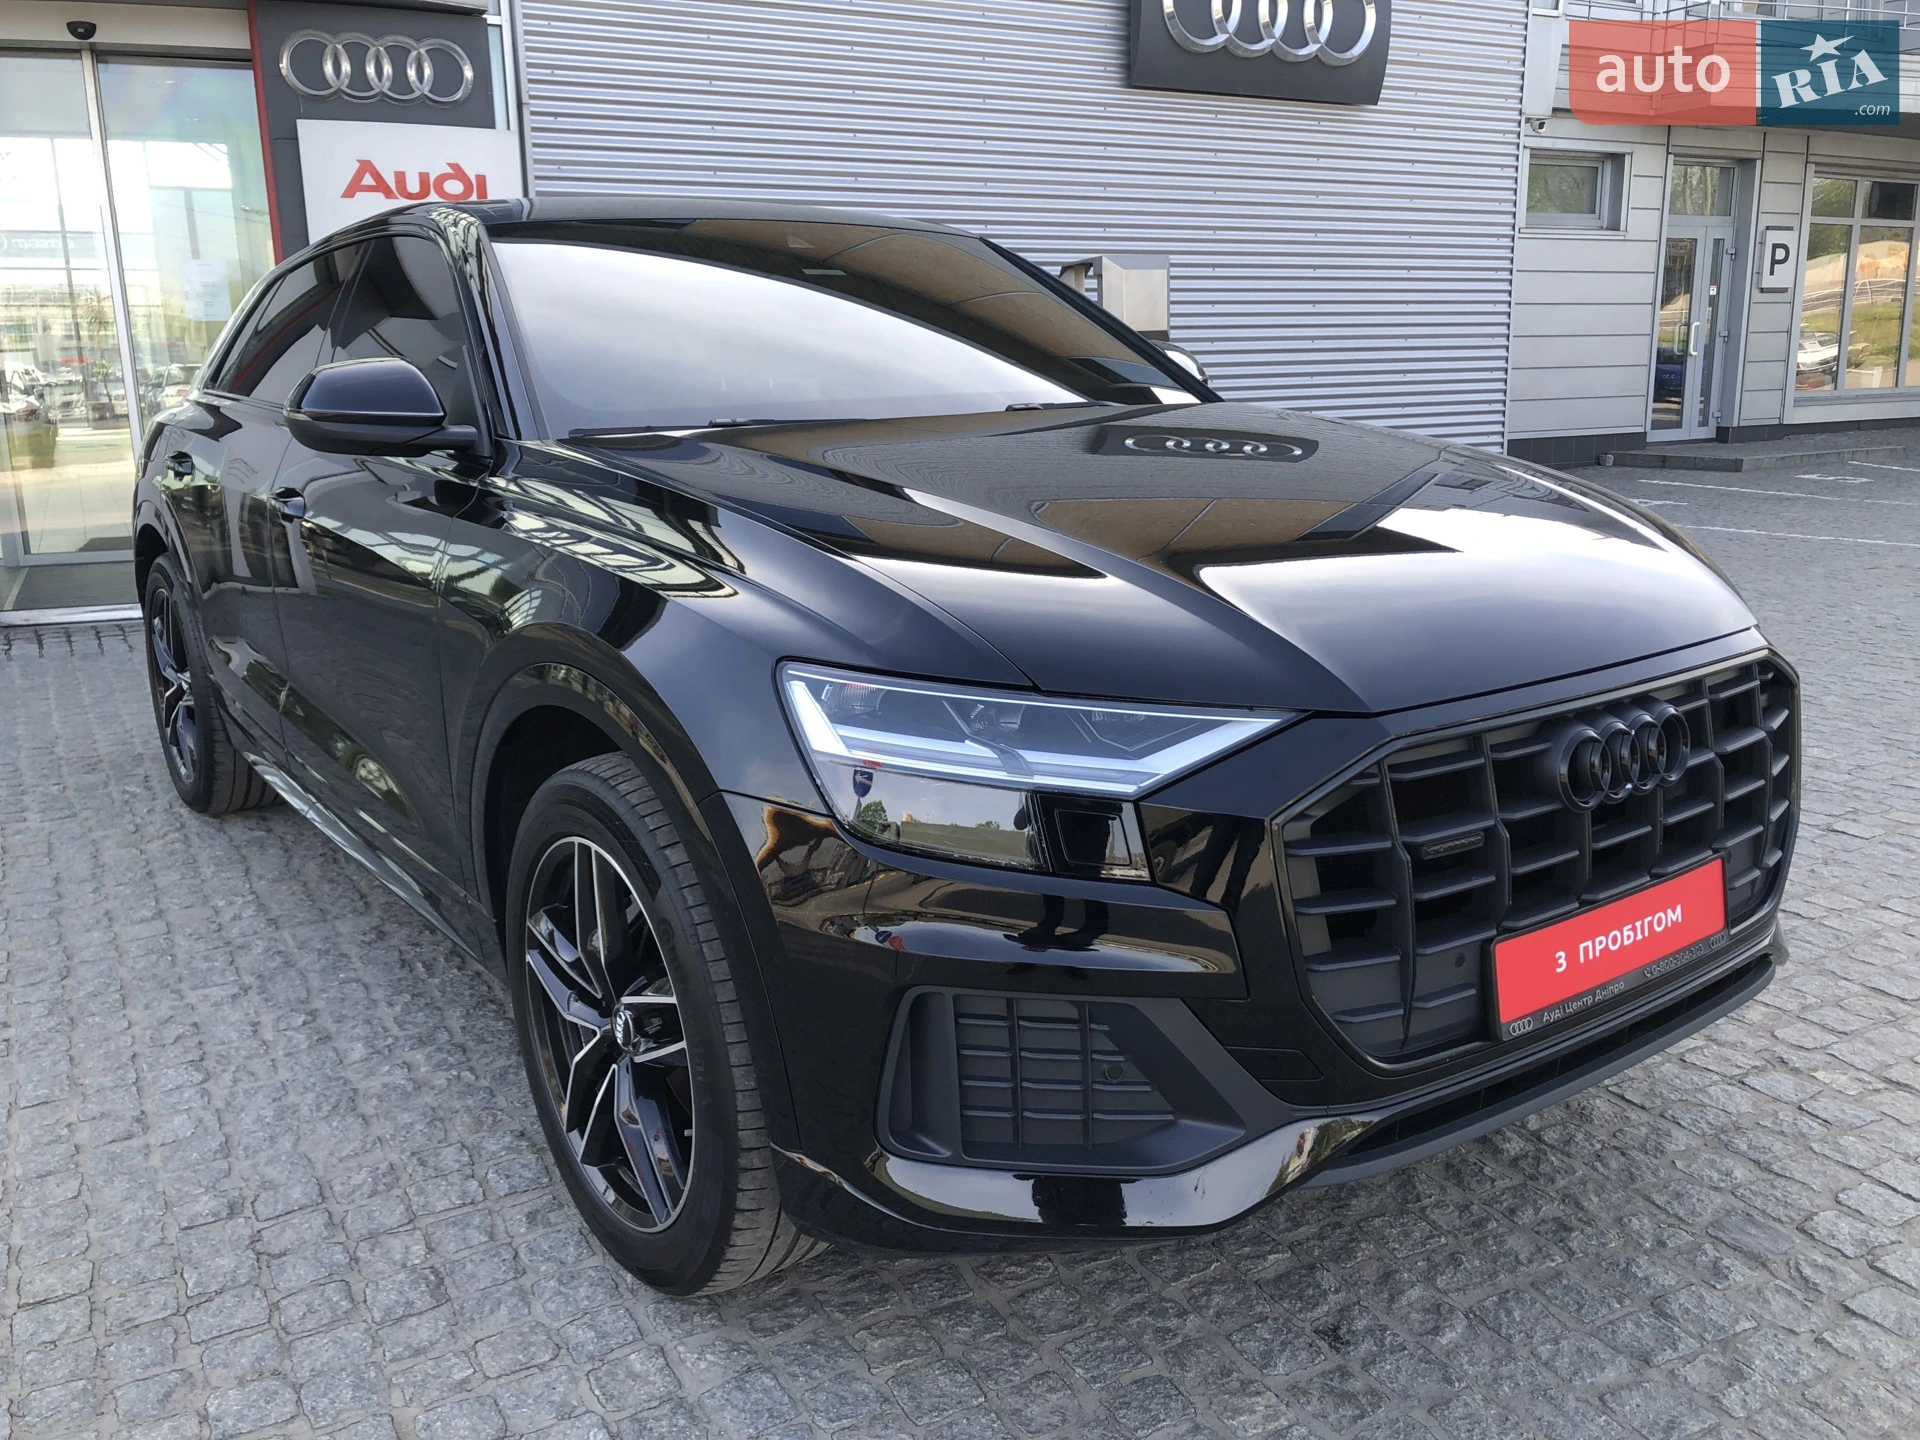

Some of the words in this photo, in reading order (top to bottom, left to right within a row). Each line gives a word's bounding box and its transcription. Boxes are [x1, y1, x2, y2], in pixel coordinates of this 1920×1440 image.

[340, 159, 489, 202] Audi
[1769, 242, 1790, 276] P
[1579, 904, 1682, 963] ПРОБІГОМ
[1542, 1006, 1564, 1022] Ауді
[1564, 995, 1593, 1014] Центр
[1594, 981, 1625, 1003] Дніпро
